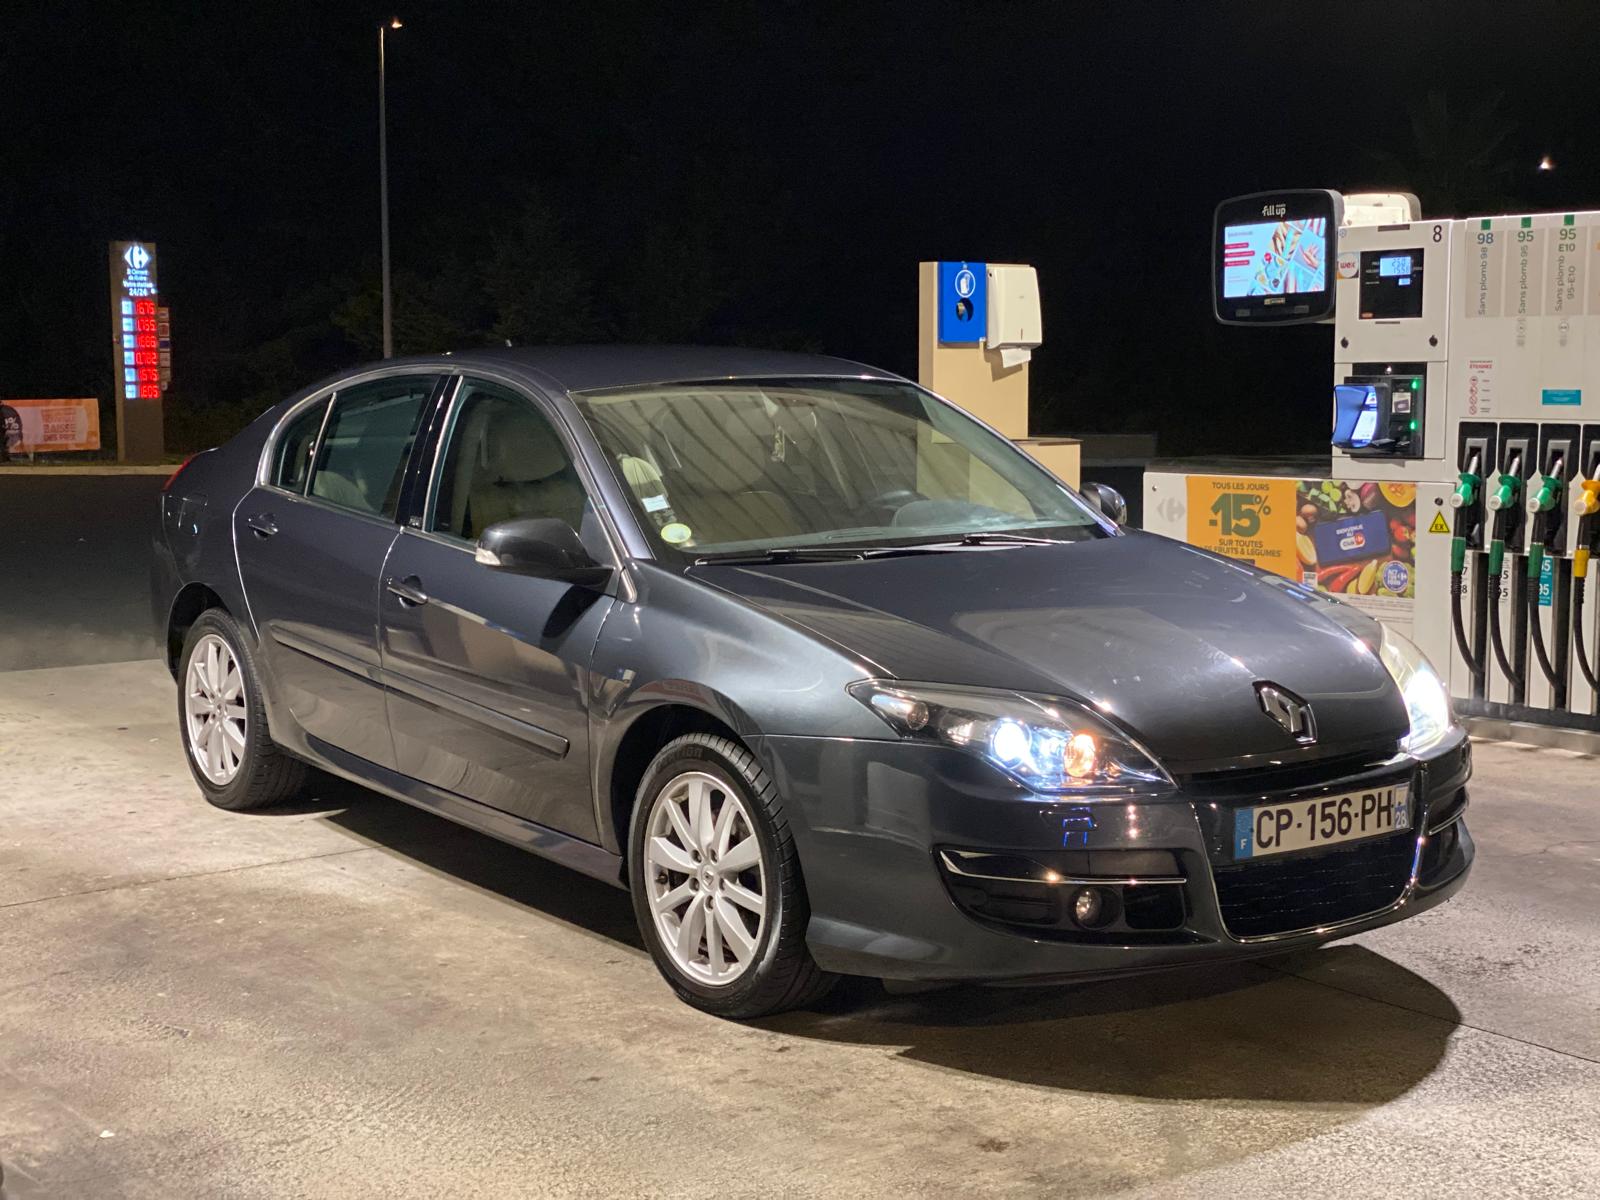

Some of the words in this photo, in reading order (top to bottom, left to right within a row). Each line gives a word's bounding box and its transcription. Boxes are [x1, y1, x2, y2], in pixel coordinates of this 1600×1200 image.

[1262, 205, 1275, 217] fill
[1275, 207, 1286, 218] up
[1432, 225, 1442, 243] 8
[1477, 232, 1494, 245] 98
[1517, 230, 1534, 243] 95
[1559, 228, 1577, 241] 95
[1481, 246, 1488, 259] 98
[1521, 245, 1529, 258] 95
[1558, 243, 1576, 252] E10
[1480, 260, 1488, 291] plomb
[1519, 259, 1528, 290] plomb
[1557, 255, 1565, 287] plomb
[1478, 292, 1486, 315] Sans
[1518, 291, 1526, 314] Sans
[1555, 287, 1564, 312] Sans
[1212, 482, 1231, 490] TOUS
[1247, 483, 1270, 491] JOURS
[1209, 493, 1271, 538] -15%
[1219, 538, 1233, 546] SUR
[1235, 539, 1264, 548] TOUTES
[1240, 838, 1248, 850] F
